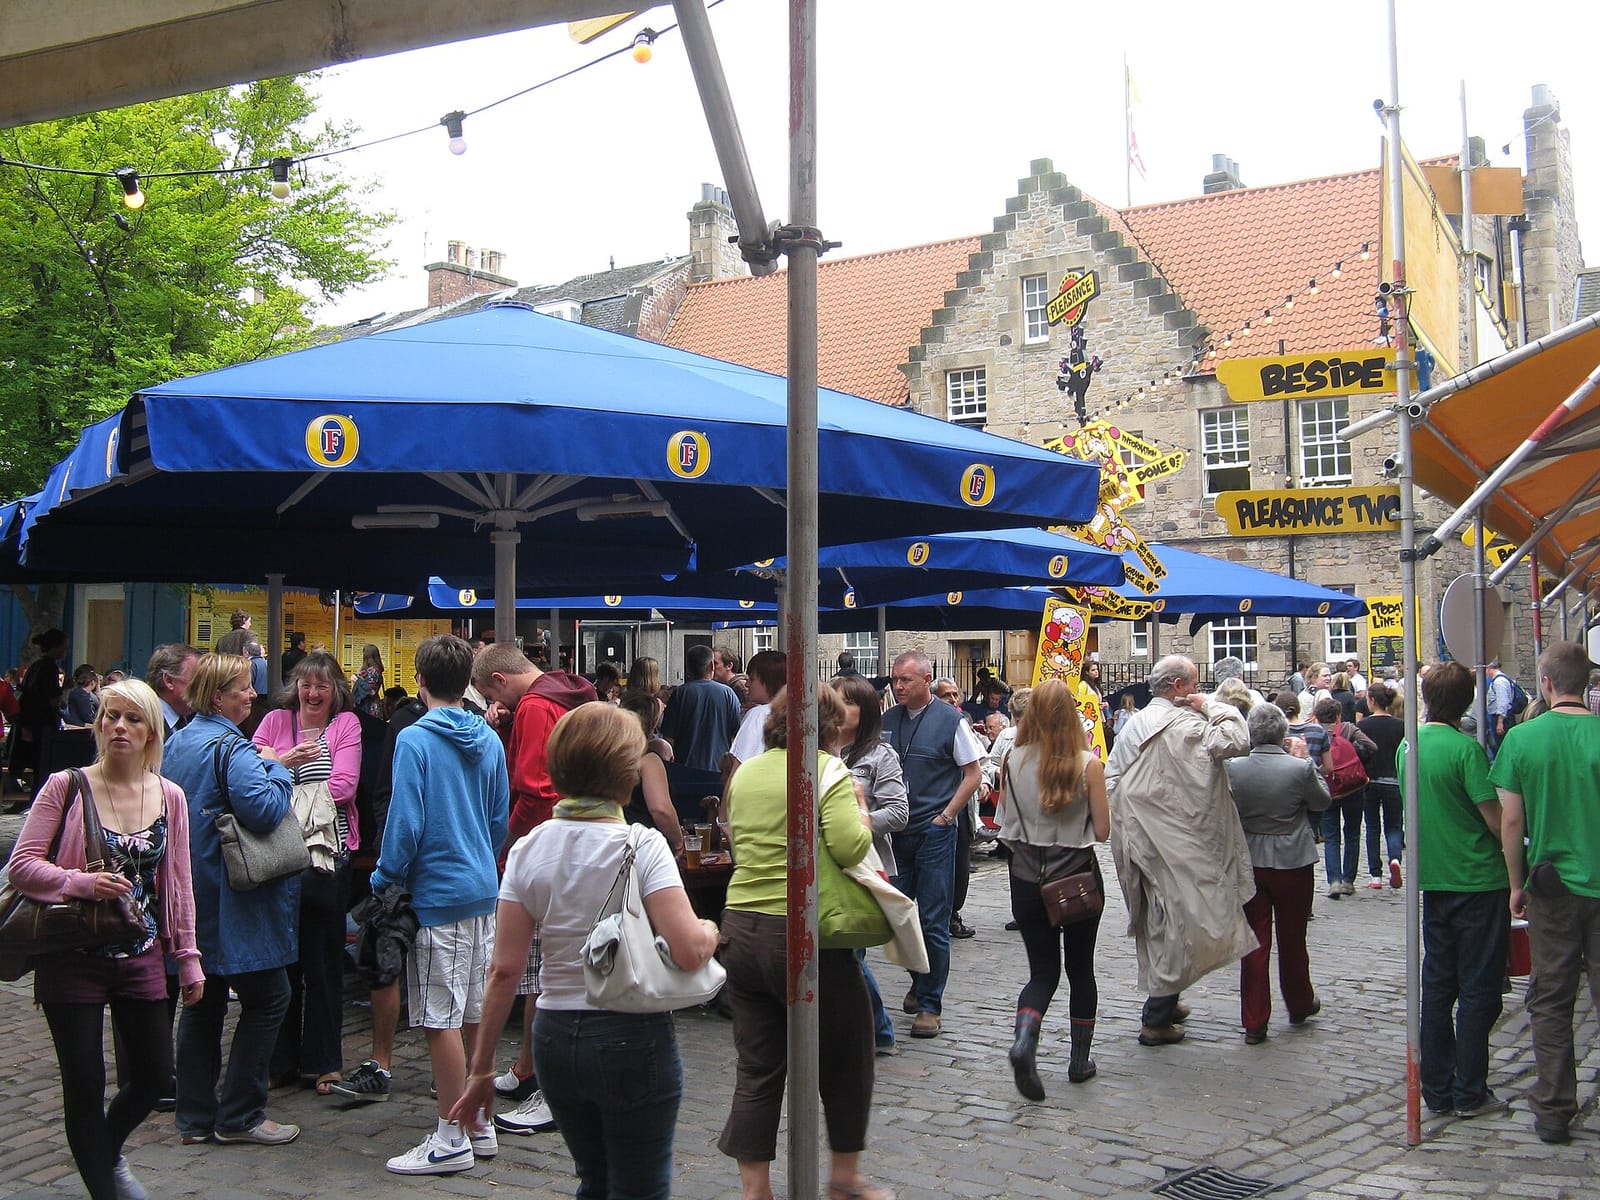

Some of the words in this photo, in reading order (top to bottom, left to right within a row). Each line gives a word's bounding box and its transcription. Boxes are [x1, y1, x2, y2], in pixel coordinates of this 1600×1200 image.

[1050, 279, 1092, 319] PLEASANCE
[1121, 434, 1158, 458] INFORMATION
[1136, 460, 1170, 482] DOME
[1235, 496, 1344, 530] PLEASANCE
